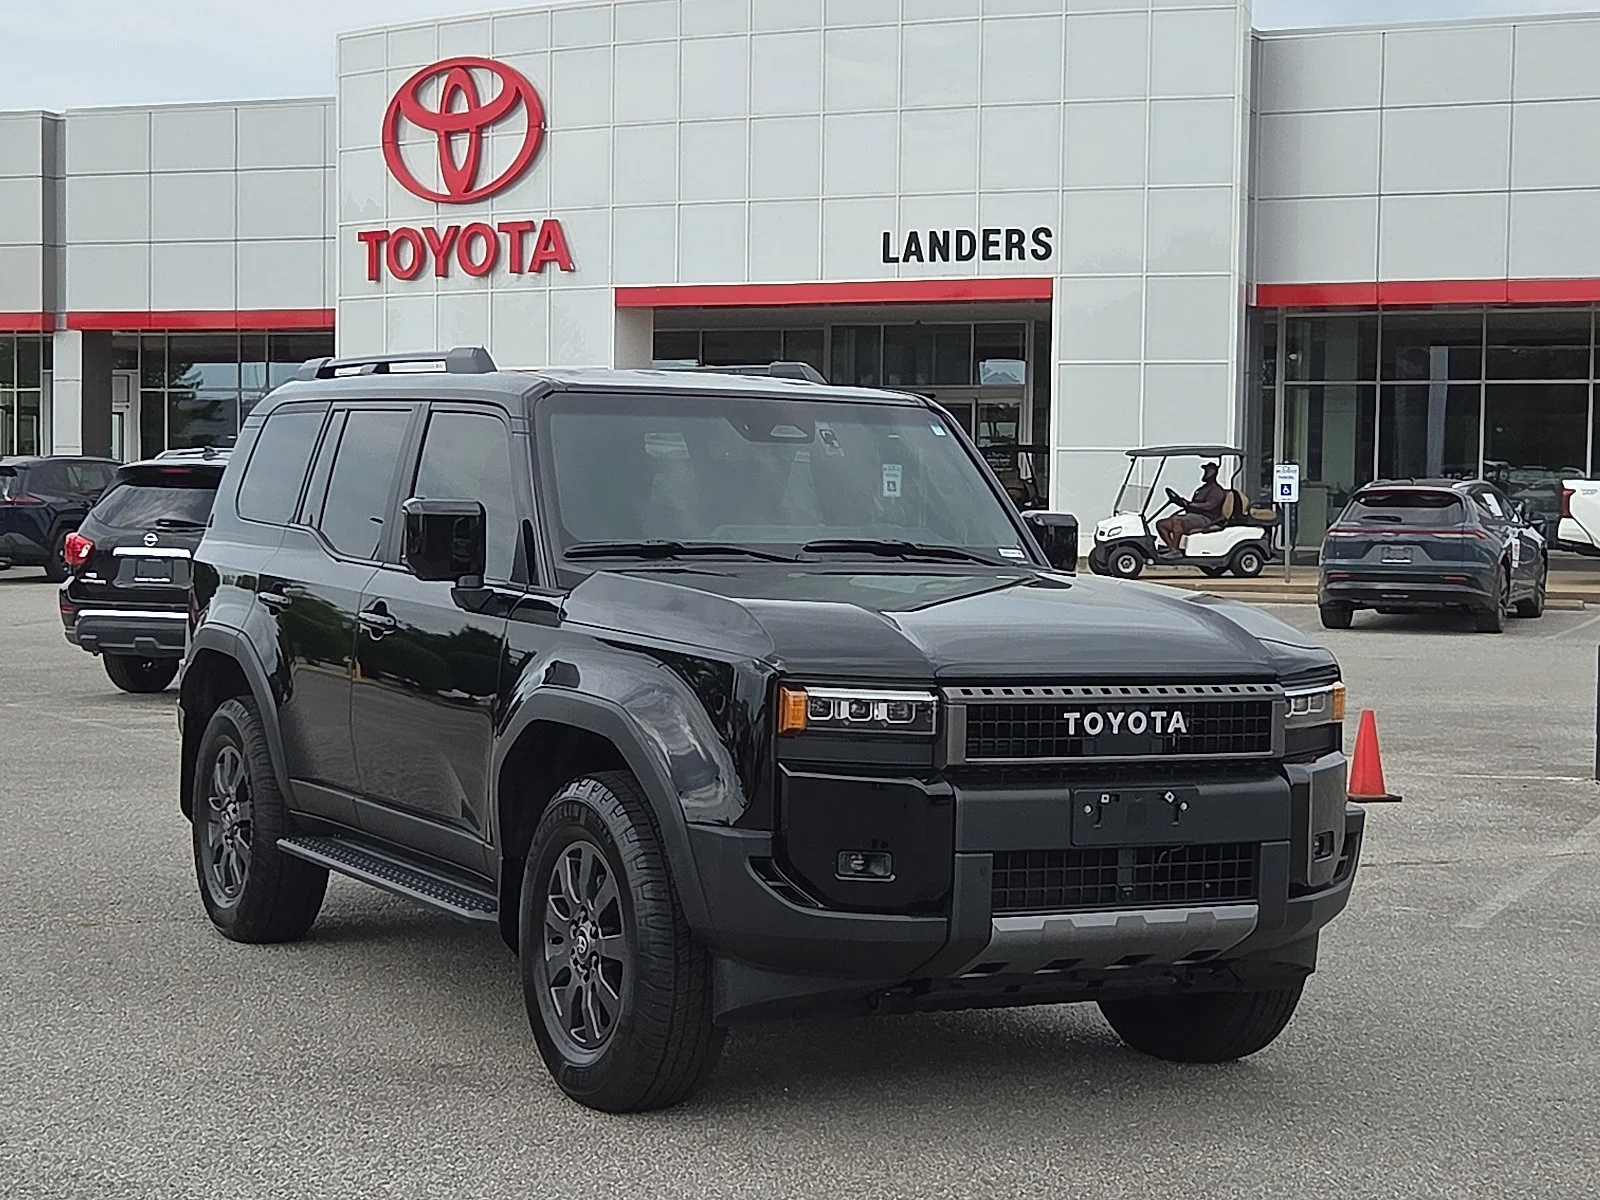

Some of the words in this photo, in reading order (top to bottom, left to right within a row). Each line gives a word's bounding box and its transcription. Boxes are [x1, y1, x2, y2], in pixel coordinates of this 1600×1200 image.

[358, 218, 574, 281] TOYOTA
[882, 226, 1053, 264] LANDERS
[1063, 710, 1187, 735] TOYOTA
